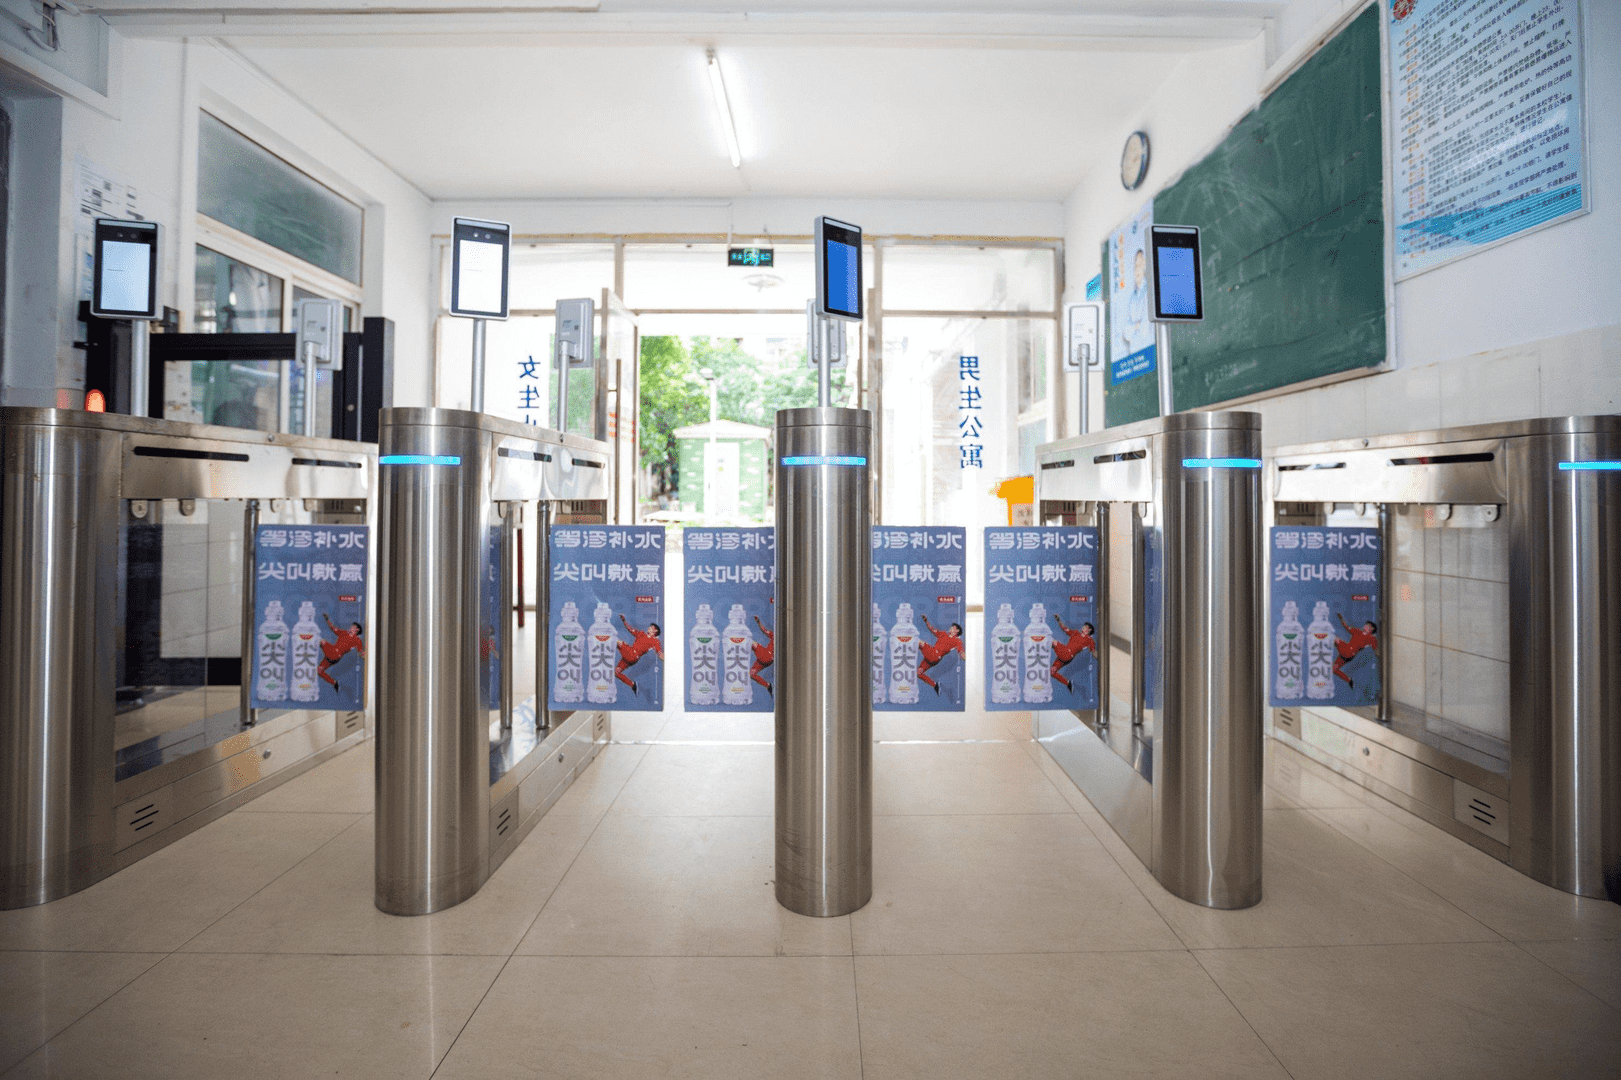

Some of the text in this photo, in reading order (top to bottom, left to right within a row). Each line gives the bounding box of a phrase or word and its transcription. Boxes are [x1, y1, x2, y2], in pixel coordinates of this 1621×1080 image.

[688, 532, 775, 550] 等渗补
[258, 562, 364, 582] 尖叫就赢
[553, 562, 660, 582] 尖叫就赢
[688, 564, 775, 584] 尖叫就
[989, 564, 1094, 583] 尖叫就赢
[1275, 564, 1377, 582] 尖叫就赢
[260, 641, 284, 683] 尖叫
[294, 641, 318, 683] 尖叫
[557, 642, 582, 684] 尖叫
[590, 643, 614, 684] 尖叫
[693, 645, 716, 686] 尖叫
[726, 645, 748, 686] 尖叫
[892, 644, 916, 684] 尖叫
[994, 644, 1017, 684] 尖叫
[1026, 644, 1049, 684] 尖叫
[1279, 640, 1302, 680] 尖叫
[1310, 640, 1332, 680] 尖叫
